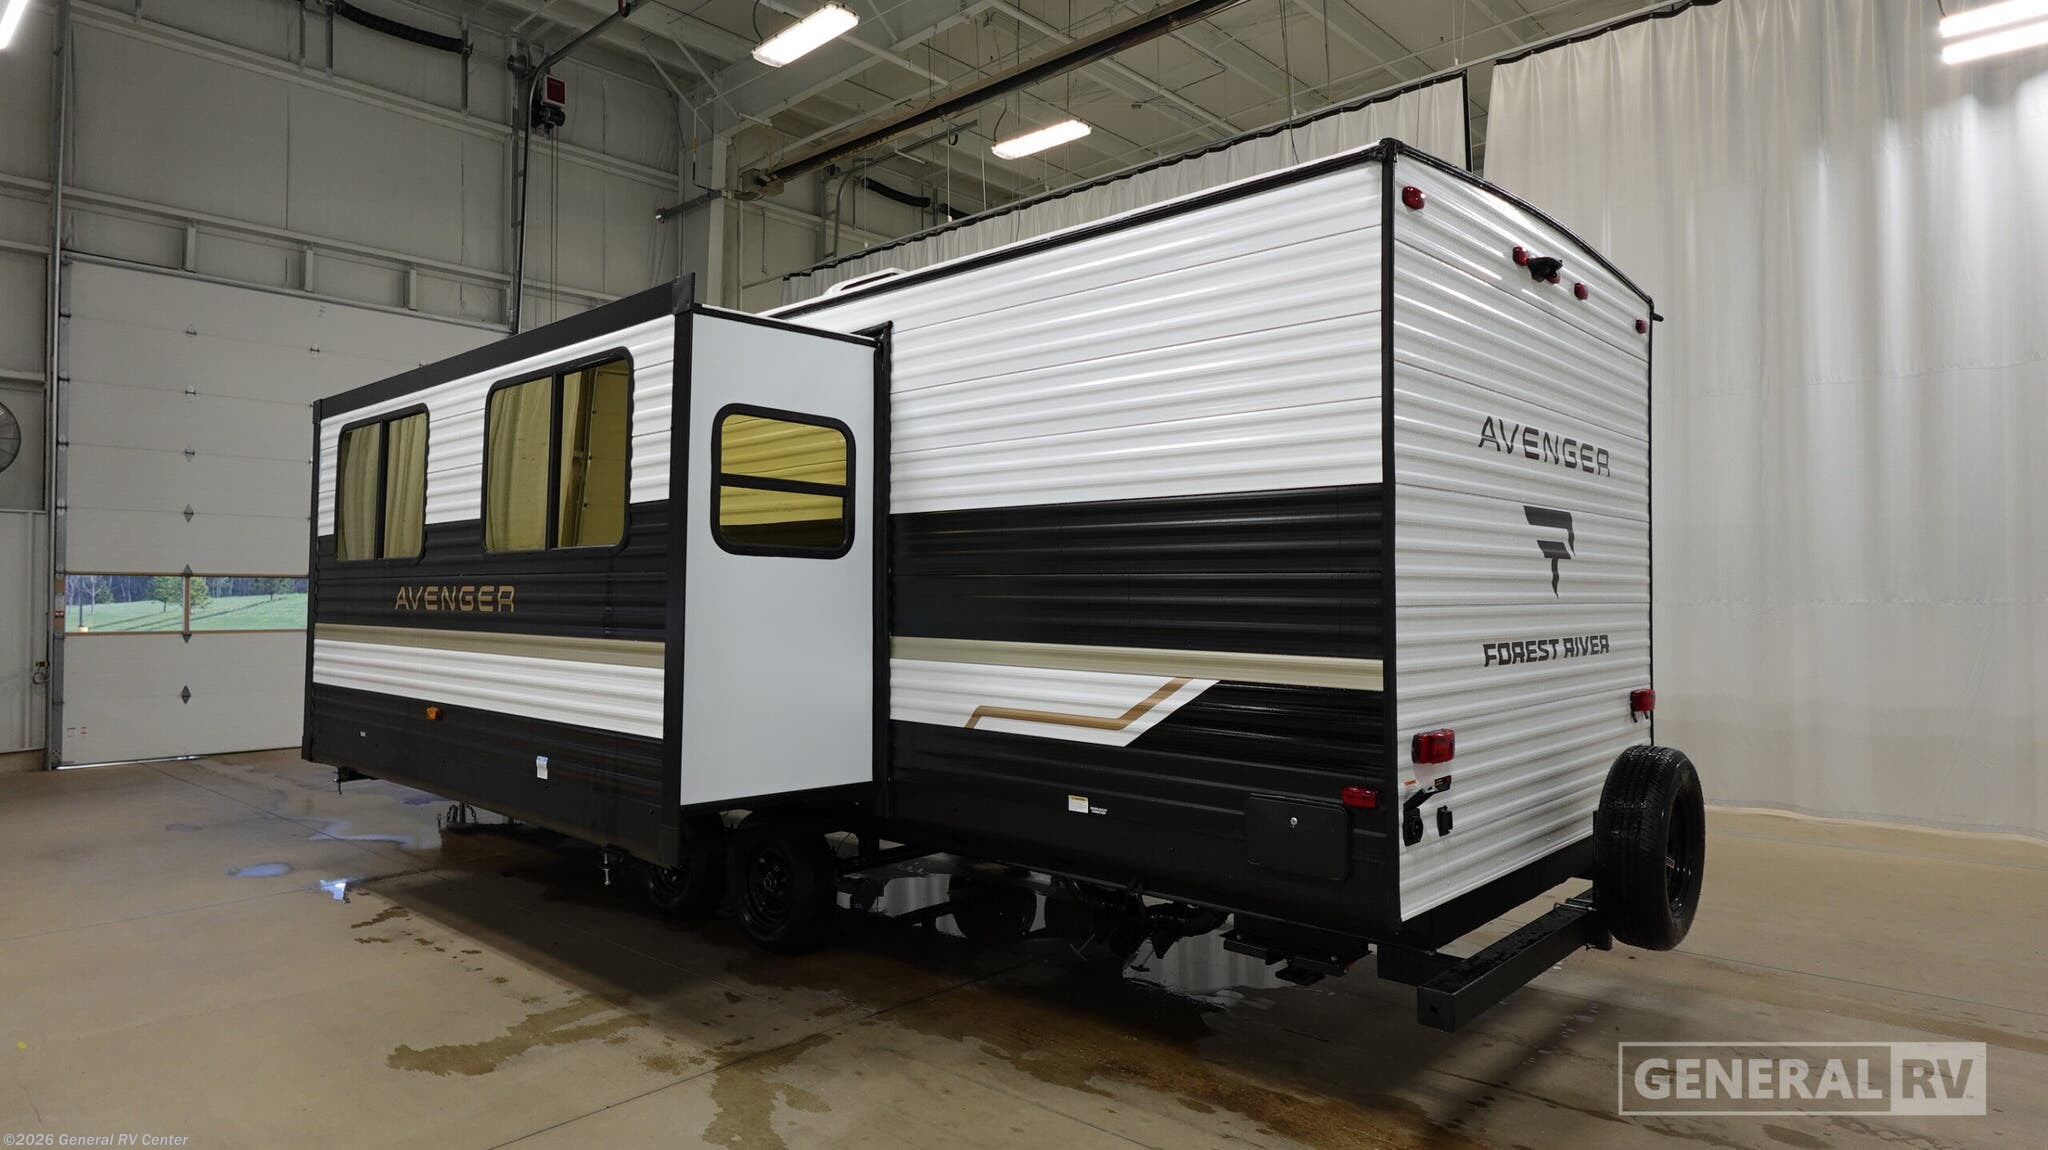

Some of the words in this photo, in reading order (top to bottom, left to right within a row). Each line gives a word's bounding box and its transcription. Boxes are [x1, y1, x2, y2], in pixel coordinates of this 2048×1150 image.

[1478, 415, 1611, 478] AVENGER
[394, 584, 516, 613] AVENGER
[1482, 638, 1559, 667] FOREST
[1562, 634, 1610, 659] RIVER
